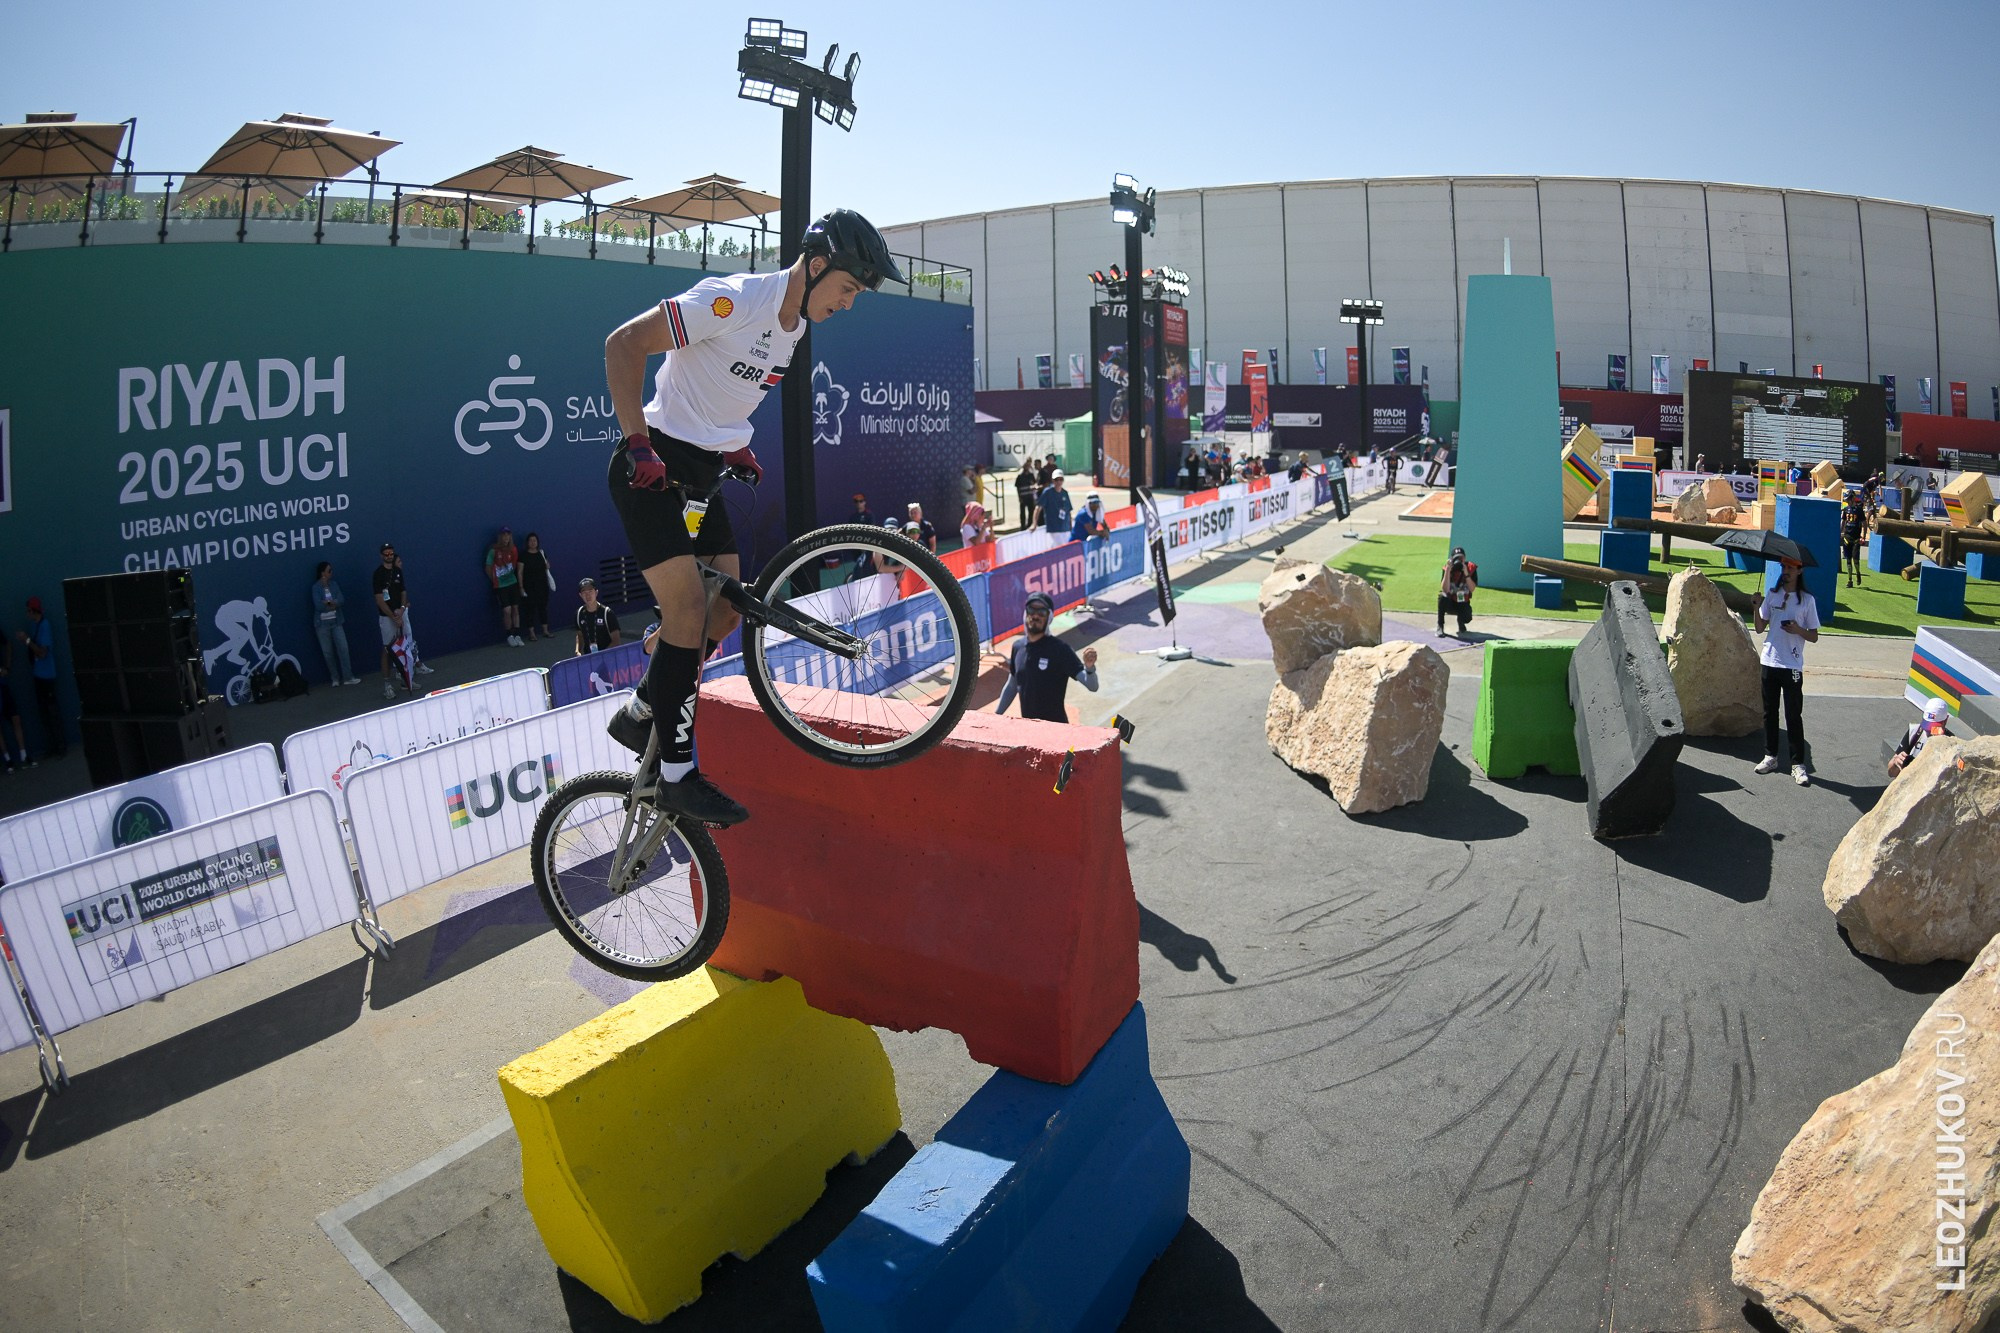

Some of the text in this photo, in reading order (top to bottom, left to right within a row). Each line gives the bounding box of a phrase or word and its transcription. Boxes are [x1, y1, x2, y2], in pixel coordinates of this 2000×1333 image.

[730, 361, 764, 382] GBR
[118, 355, 345, 434] RIYADH
[566, 396, 615, 419] SAU
[860, 381, 950, 411] وزارة الرياضة
[1660, 405, 1684, 414] RIYAD
[860, 414, 950, 437] Ministry of Sport
[1373, 408, 1406, 417] RIYADH
[1003, 445, 1026, 455] UCI
[1329, 460, 1339, 472] 2
[118, 432, 348, 504] 2025 UCI
[121, 494, 350, 540] URBAN CYCLING WORLD
[1262, 491, 1290, 516] TISSOT
[1190, 507, 1234, 541] TISSOT
[124, 523, 350, 574] CHAMPIONSHIPS
[1024, 543, 1123, 597] SHIMANO
[466, 753, 557, 818] UCI
[138, 852, 254, 899] 2025 URBAN CYCLING
[142, 890, 185, 914] WORLD
[185, 858, 278, 899] CHAMPIONSHIPS
[76, 893, 134, 934] UCI
[151, 915, 190, 938] RIYADH
[156, 918, 227, 952] SAUDI ARABIA
